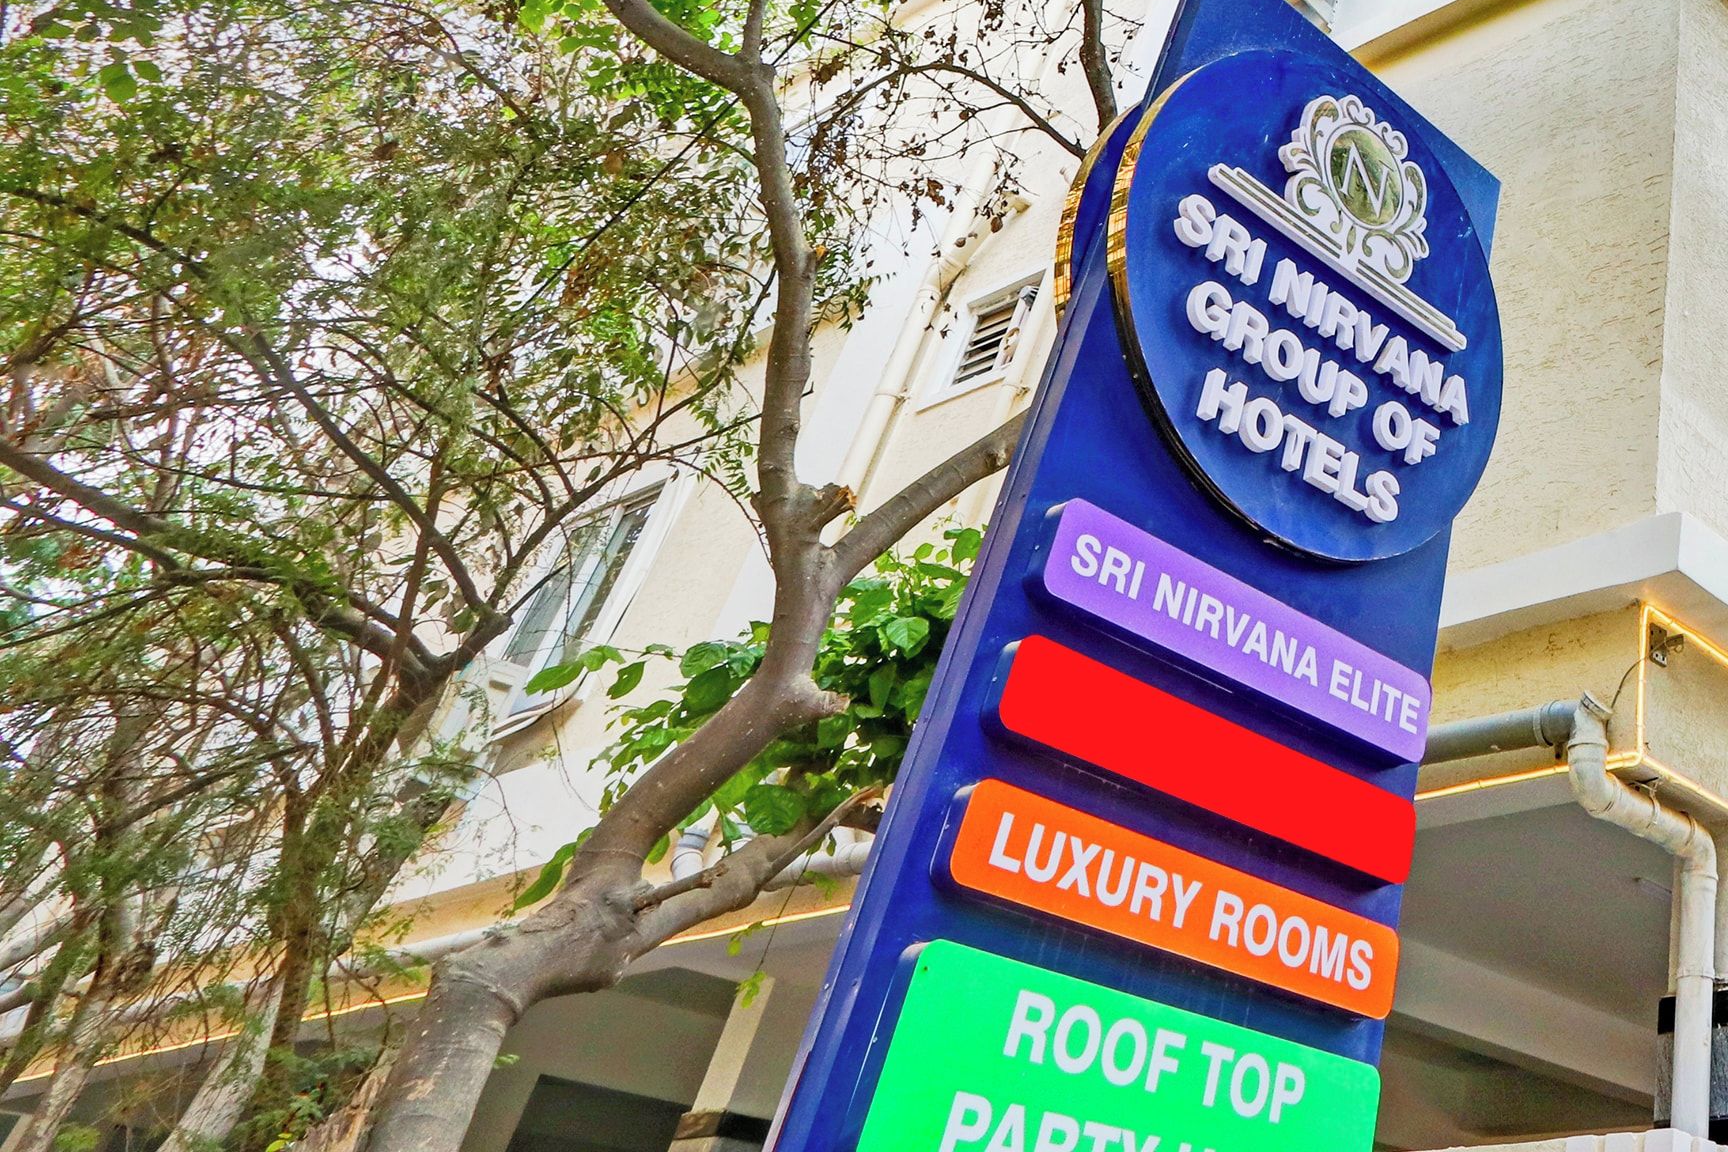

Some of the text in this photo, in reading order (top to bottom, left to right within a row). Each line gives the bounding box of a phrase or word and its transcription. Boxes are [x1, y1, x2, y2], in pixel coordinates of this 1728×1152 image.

[1340, 140, 1394, 218] N
[1173, 194, 1470, 426] SRI NIRVANA
[1186, 280, 1441, 465] GROUP OF
[1196, 367, 1401, 524] HOTELS
[1071, 533, 1421, 734] SRI NIRVANA ELITE
[988, 812, 1373, 991] LUXURY ROOMS
[1002, 989, 1306, 1124] ROOF TOP
